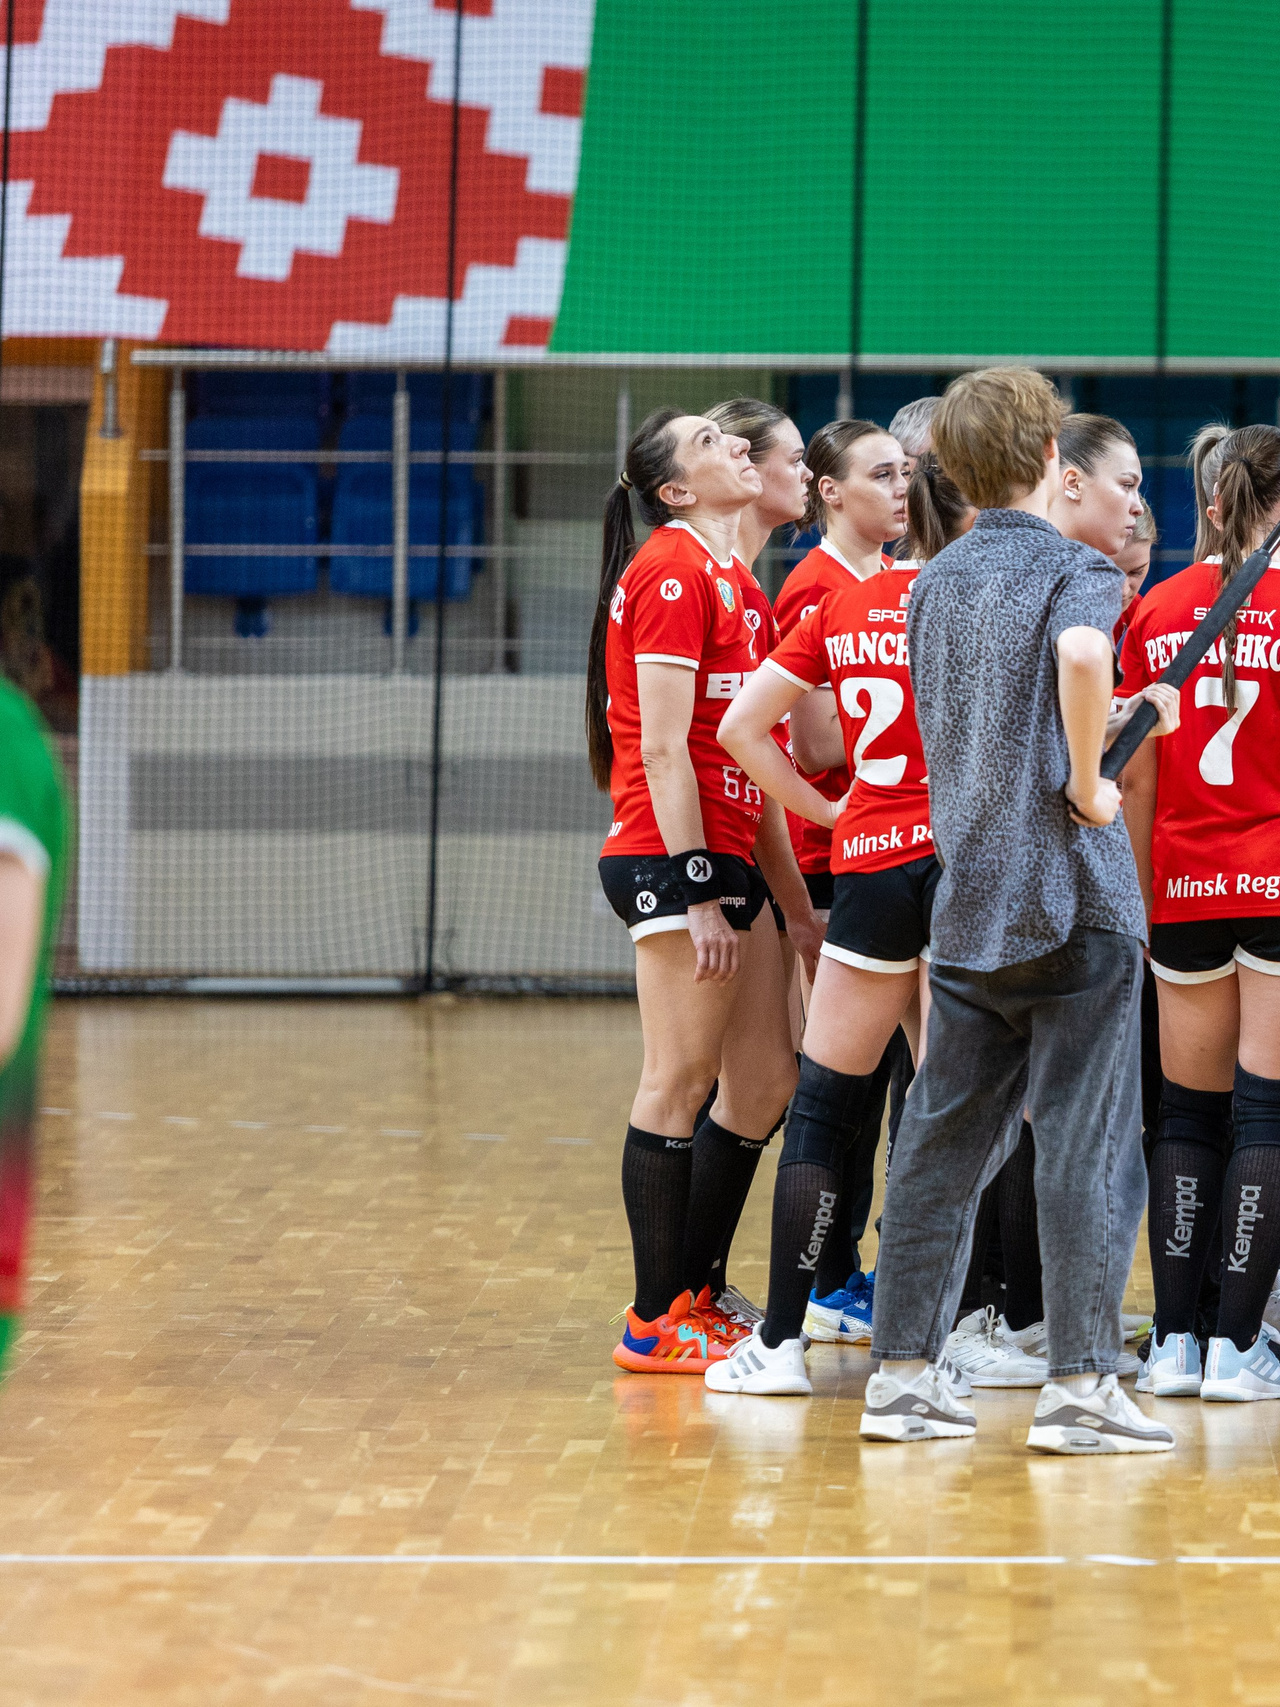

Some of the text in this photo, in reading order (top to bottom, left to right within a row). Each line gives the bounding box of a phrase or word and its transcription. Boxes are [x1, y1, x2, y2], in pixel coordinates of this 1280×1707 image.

[1194, 607, 1276, 630] SRTIX
[1195, 676, 1260, 786] 7
[843, 825, 904, 860] Minsk
[718, 895, 746, 909] empa
[1166, 872, 1229, 899] Minsk
[797, 1189, 838, 1272] Kempa
[1165, 1174, 1205, 1259] Kempa
[1227, 1184, 1265, 1274] Kempa
